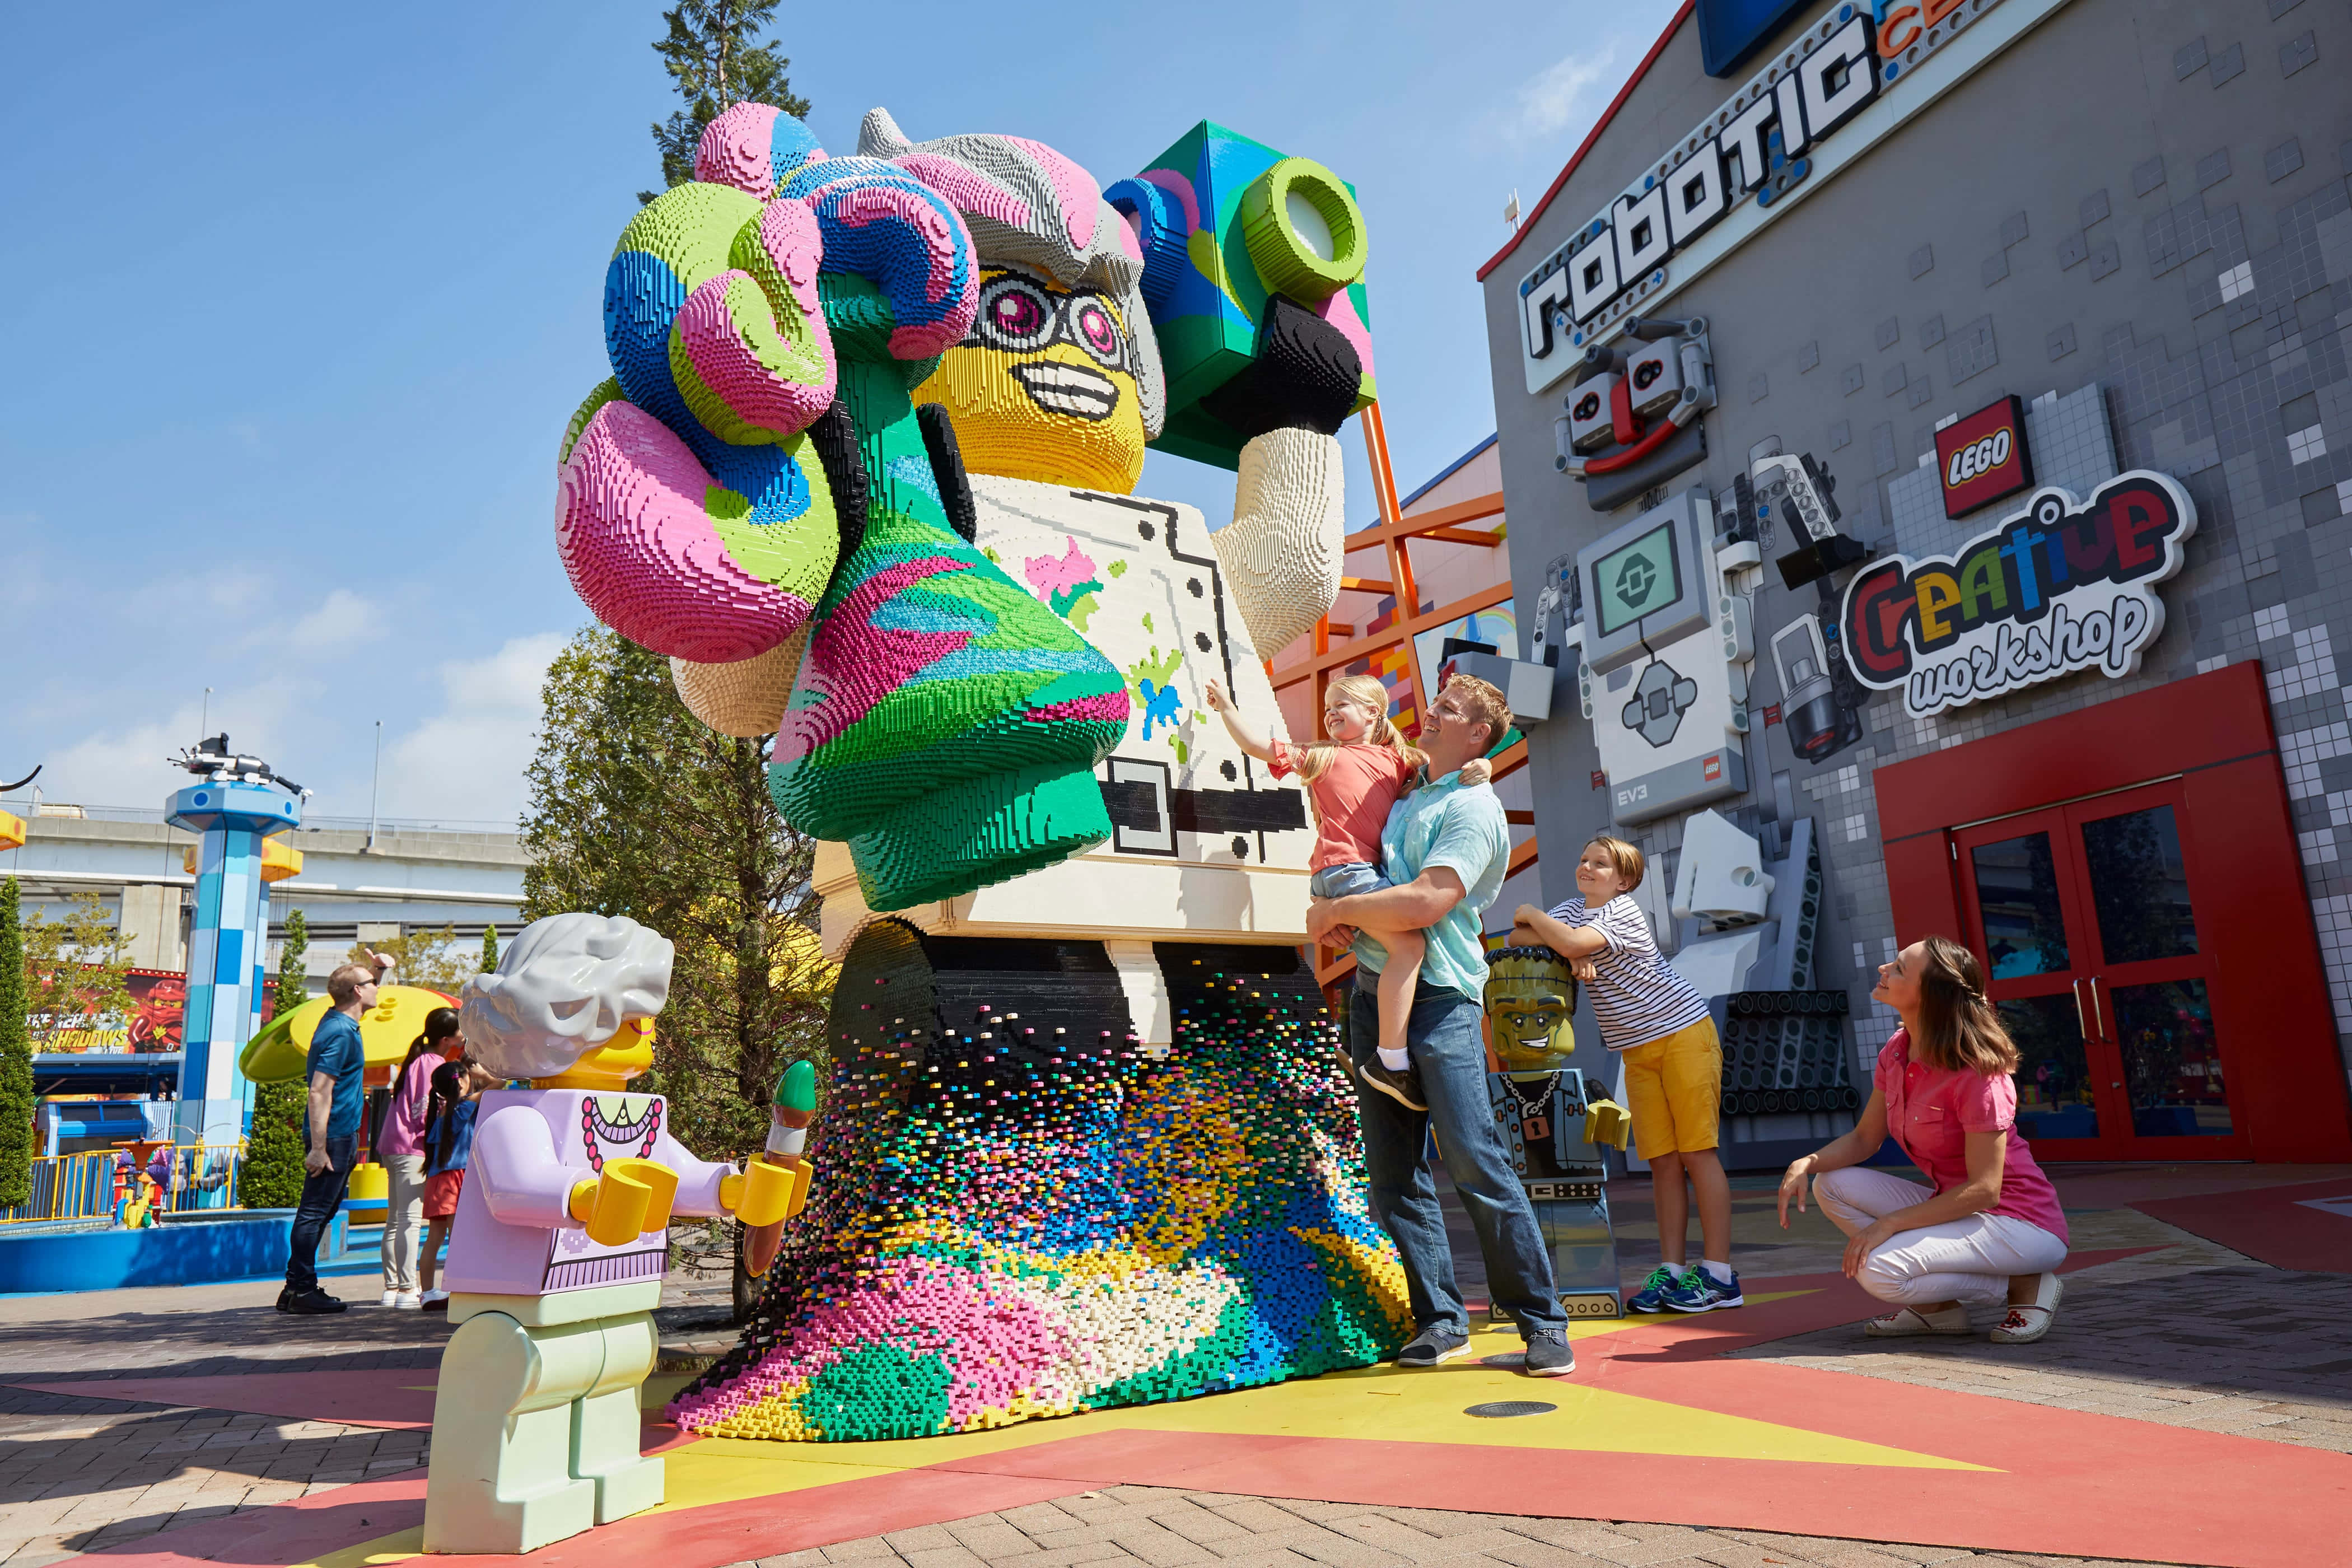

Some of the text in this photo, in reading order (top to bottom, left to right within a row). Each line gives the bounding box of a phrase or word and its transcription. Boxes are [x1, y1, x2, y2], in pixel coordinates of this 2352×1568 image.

[1948, 429, 2010, 487] LEGO
[1908, 595, 2148, 713] workshop
[1705, 762, 1719, 774] LEGO
[1617, 784, 1648, 806] EV3
[44, 1029, 129, 1047] SHADOWS
